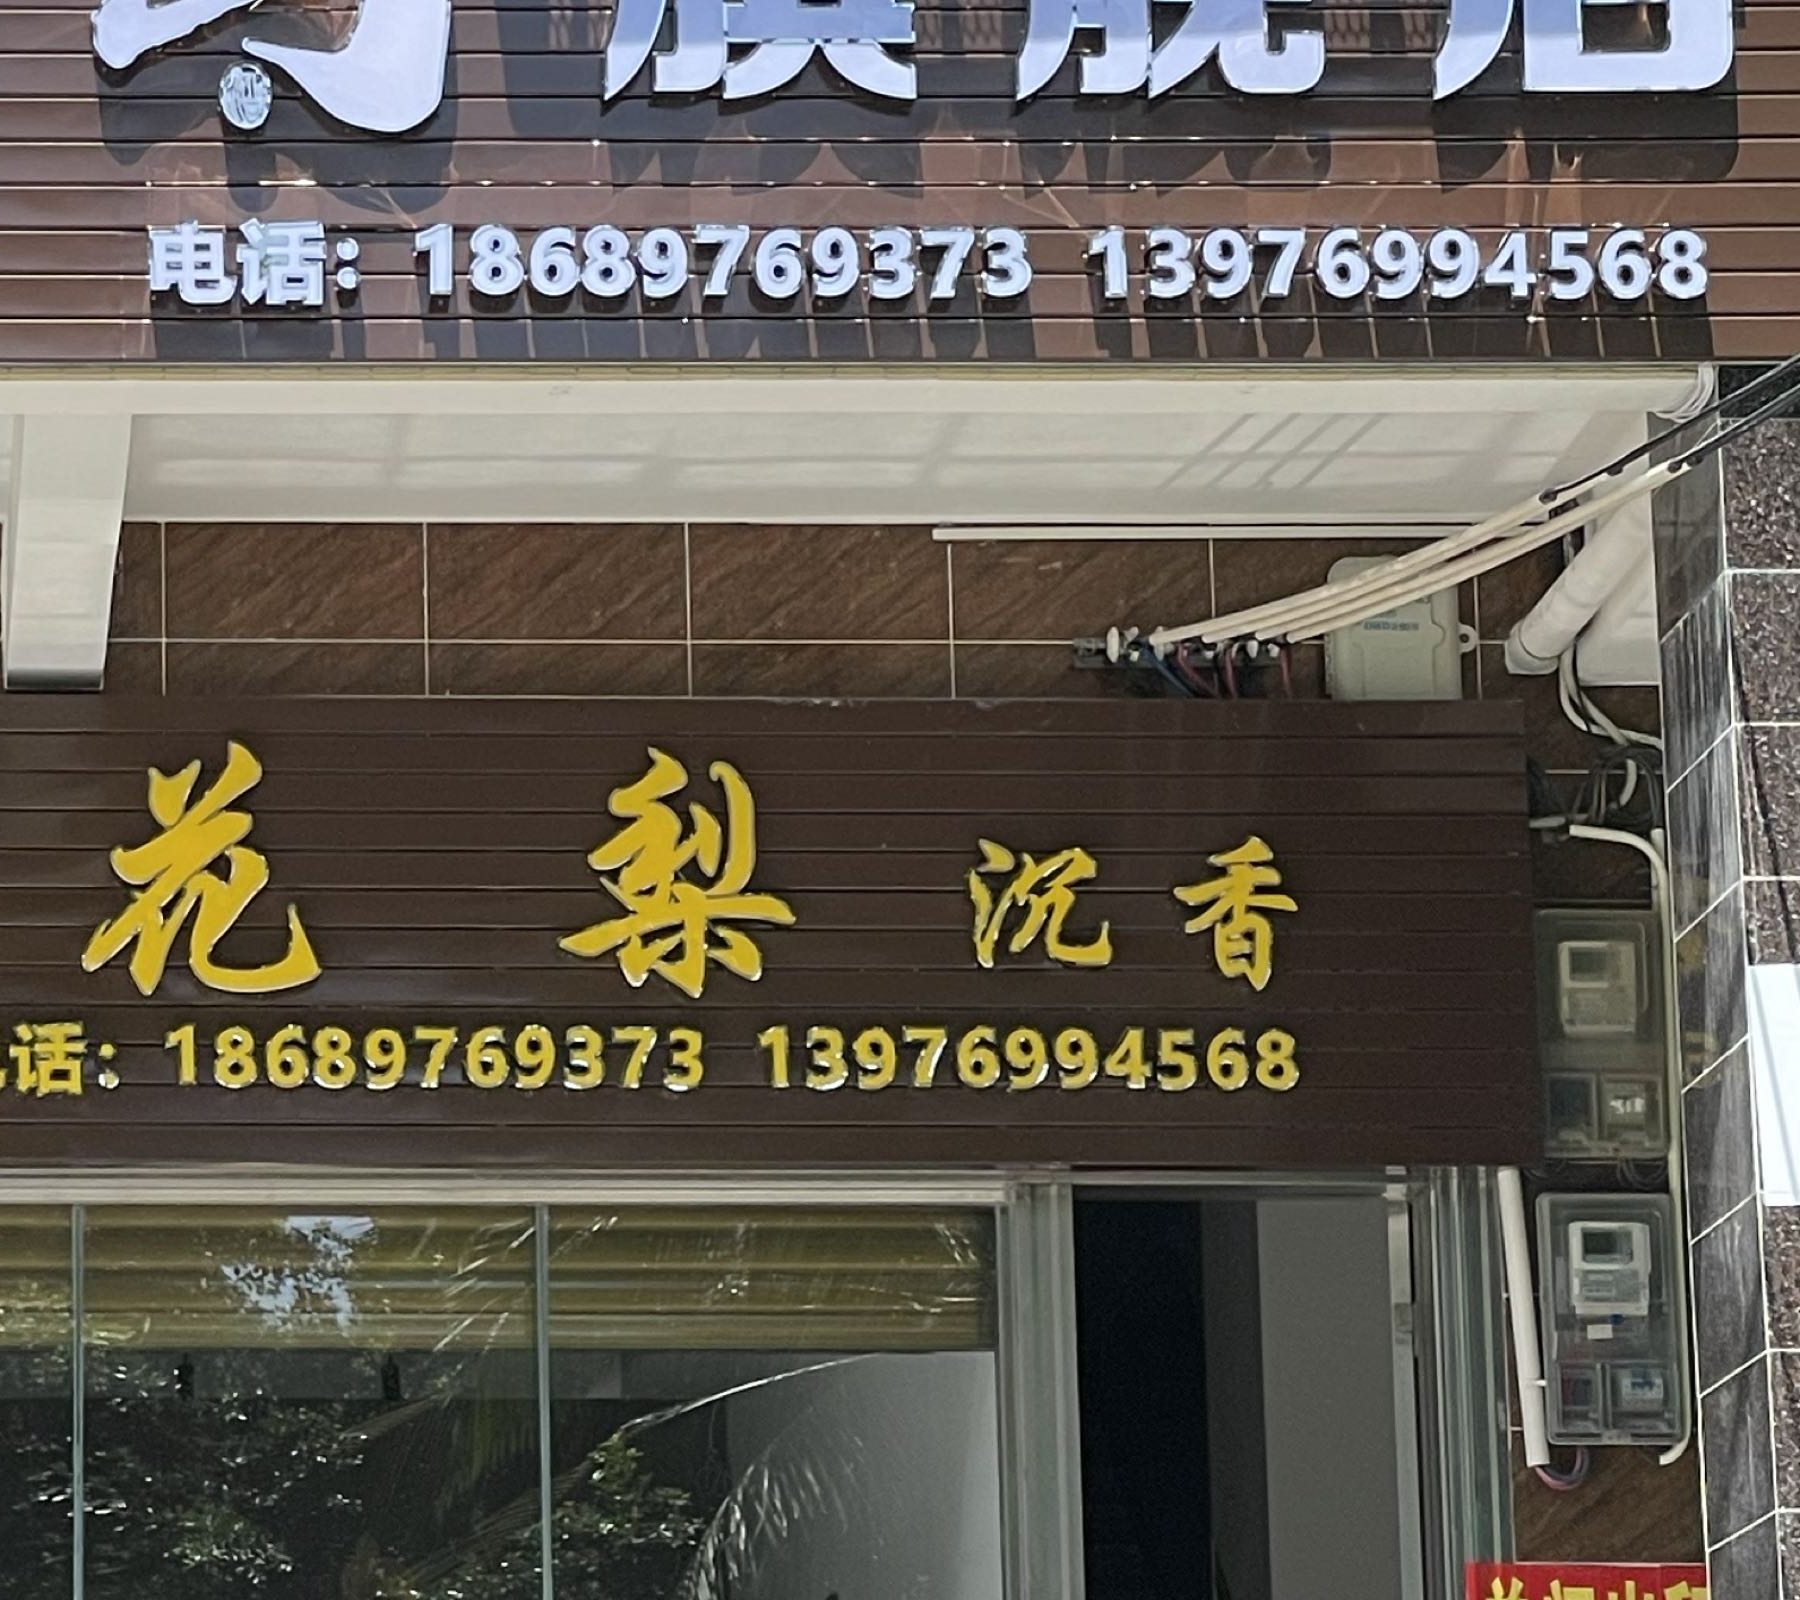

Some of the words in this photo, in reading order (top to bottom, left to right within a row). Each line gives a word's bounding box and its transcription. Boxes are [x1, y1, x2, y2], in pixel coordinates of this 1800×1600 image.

[412, 222, 1035, 300] 18689769373
[1090, 226, 1708, 300] 13976994568
[164, 1023, 707, 1091] 18689769373
[757, 1024, 1301, 1091] 13976994568
